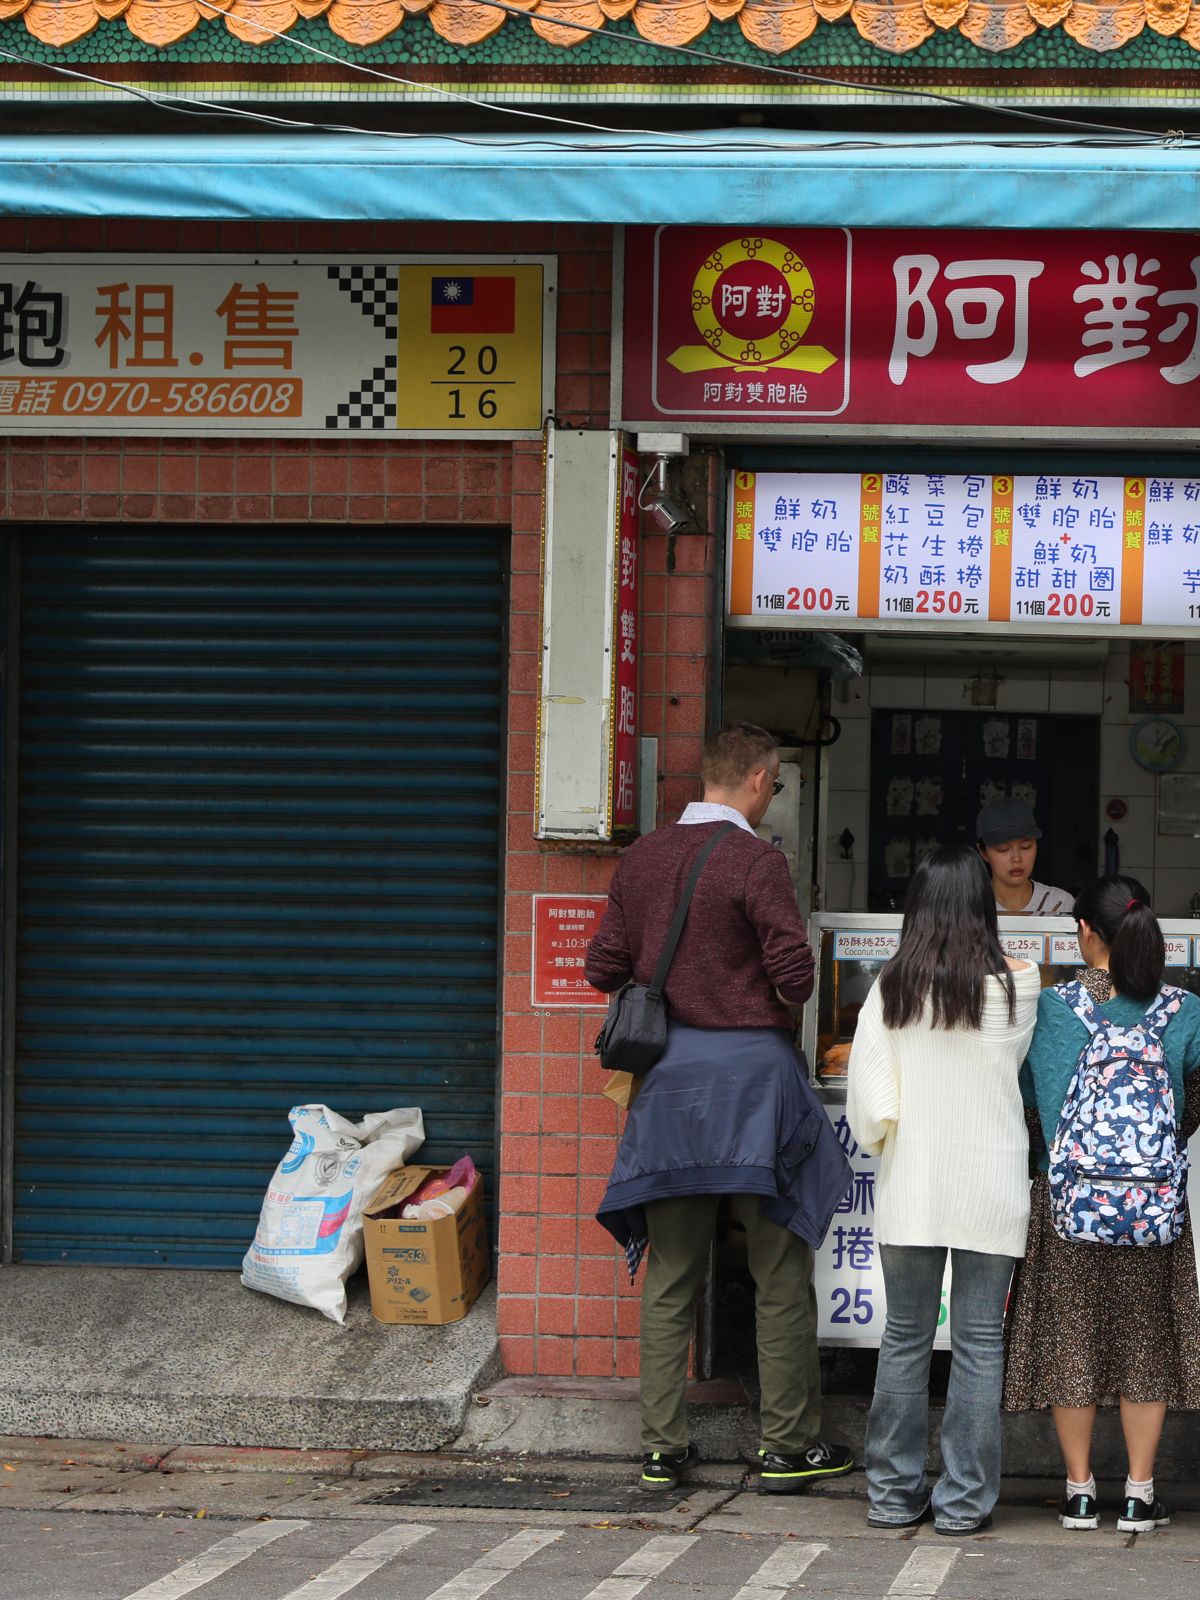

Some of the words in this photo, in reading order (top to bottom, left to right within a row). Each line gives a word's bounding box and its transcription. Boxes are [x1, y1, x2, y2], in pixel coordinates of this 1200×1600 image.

[721, 283, 787, 318] 阿對
[447, 345, 499, 376] 20
[62, 381, 295, 414] 0970-586608
[447, 389, 499, 419] 16
[703, 382, 808, 405] 阿對雙胞胎
[885, 475, 986, 497] 酸菜包
[1035, 476, 1099, 500] 鮮奶
[774, 496, 838, 521] 鮮奶
[885, 504, 986, 527] 紅豆包
[1017, 505, 1117, 529] 雙胞胎
[758, 528, 853, 554] 雙胞胎
[884, 534, 984, 558] 花生捲
[1033, 541, 1097, 565] 鮮奶
[884, 564, 983, 589] 奶酥捲
[1015, 567, 1114, 592] 甜甜圈
[755, 587, 850, 612] 11個200元
[885, 591, 980, 616] 11個250元
[1016, 593, 1111, 618] 11個200元
[616, 460, 639, 812] 阿對雙胞胎
[548, 908, 595, 919] 阿對雙胞胎
[838, 936, 898, 947] 奶酥捲25元
[844, 948, 874, 956] Coconut
[875, 948, 890, 956] milk
[830, 1287, 874, 1325] 25
